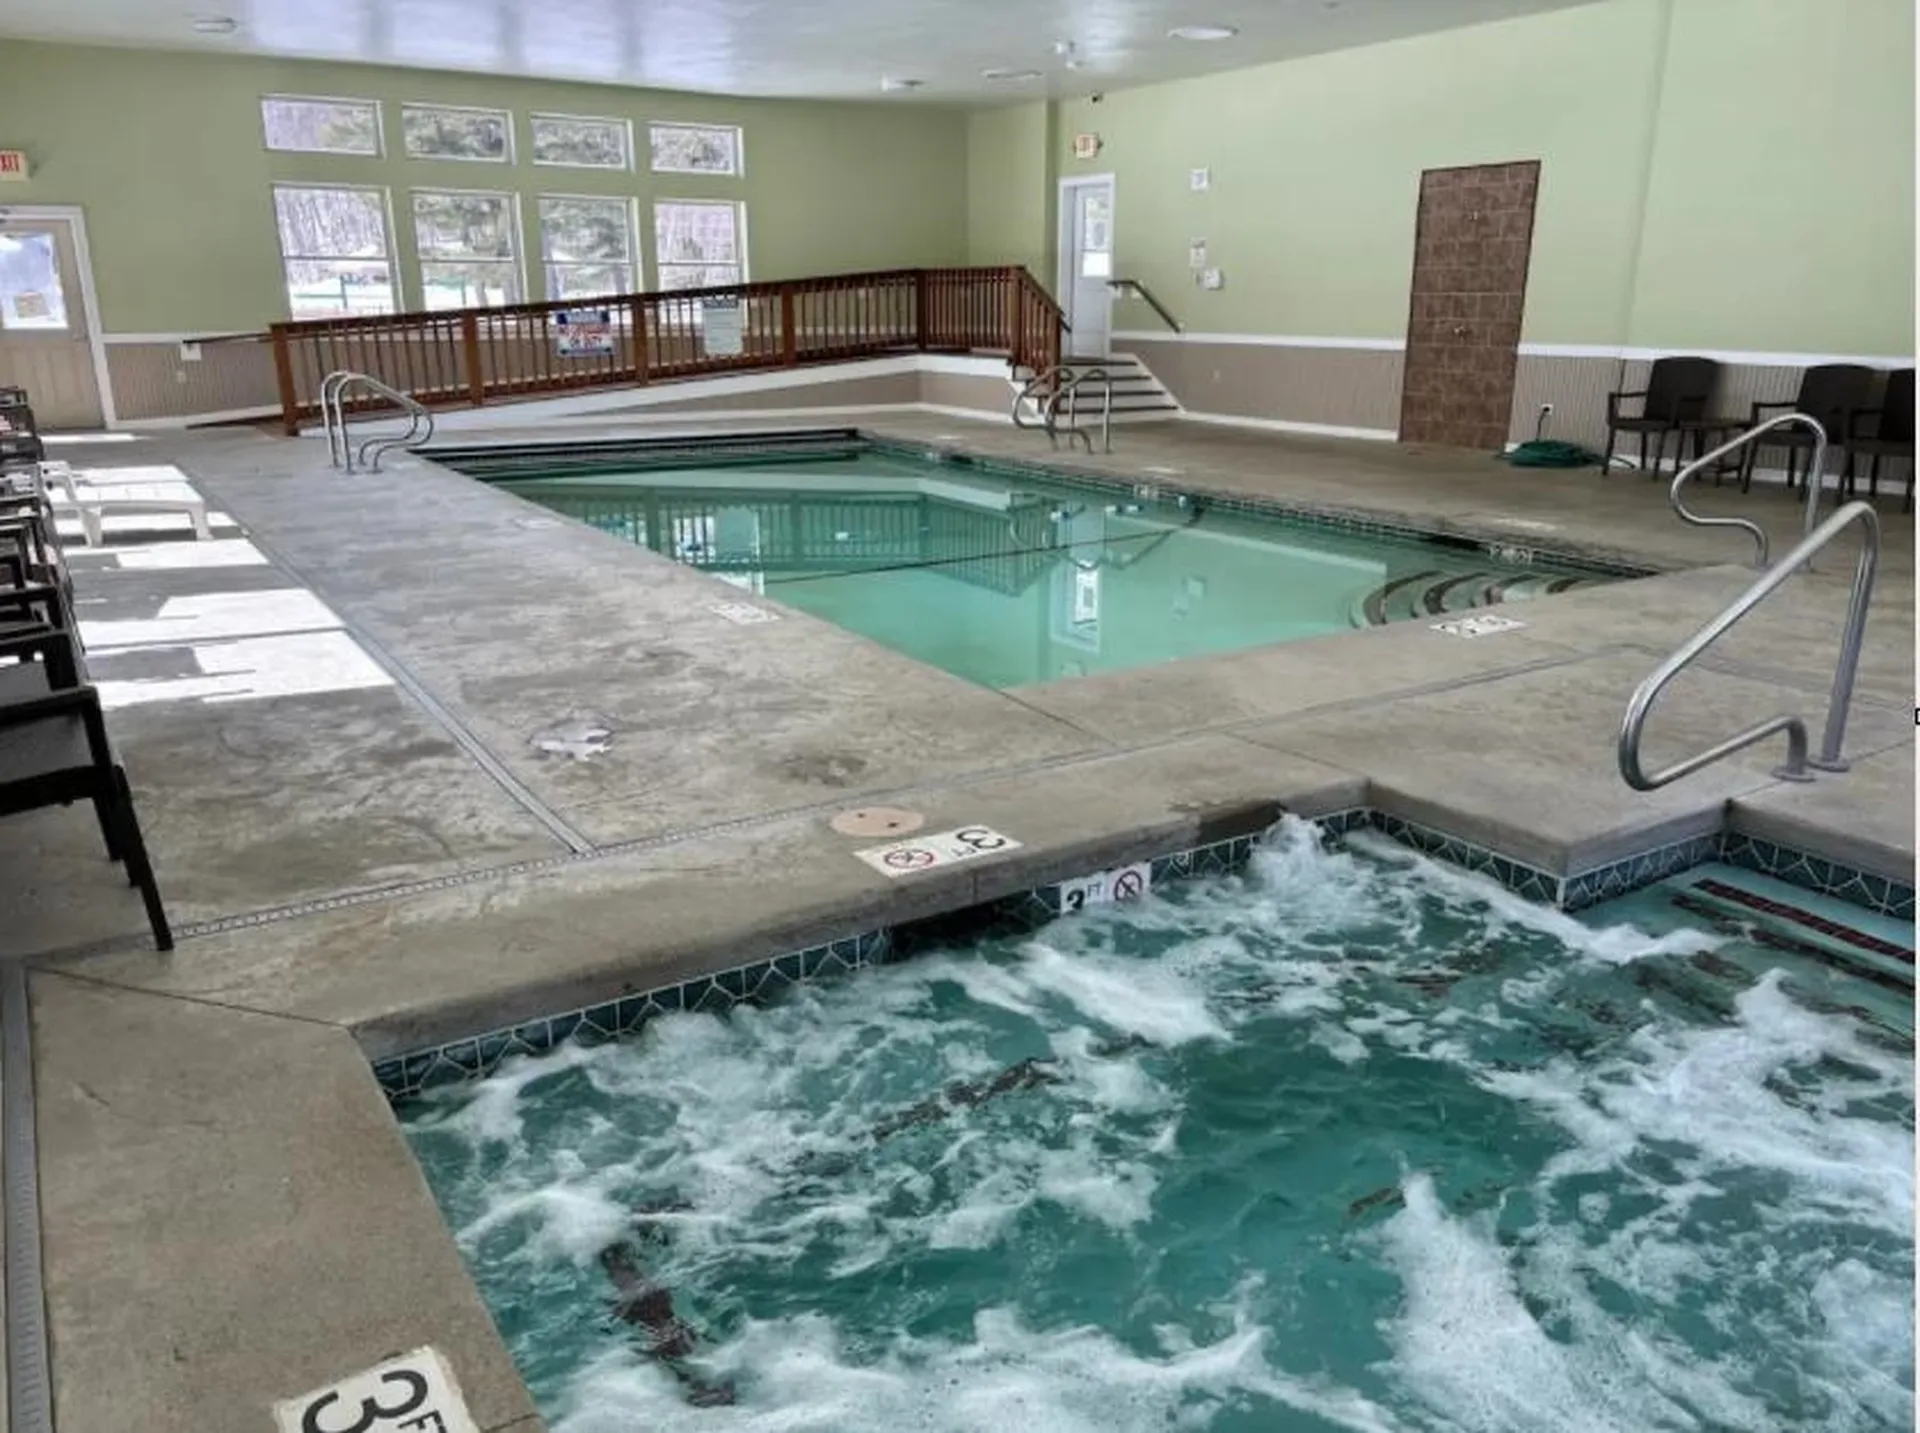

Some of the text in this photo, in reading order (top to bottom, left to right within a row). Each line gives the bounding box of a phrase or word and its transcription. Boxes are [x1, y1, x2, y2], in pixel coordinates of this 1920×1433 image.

[0, 155, 19, 172] XIT
[957, 829, 1005, 849] 3
[302, 1370, 428, 1433] 3
